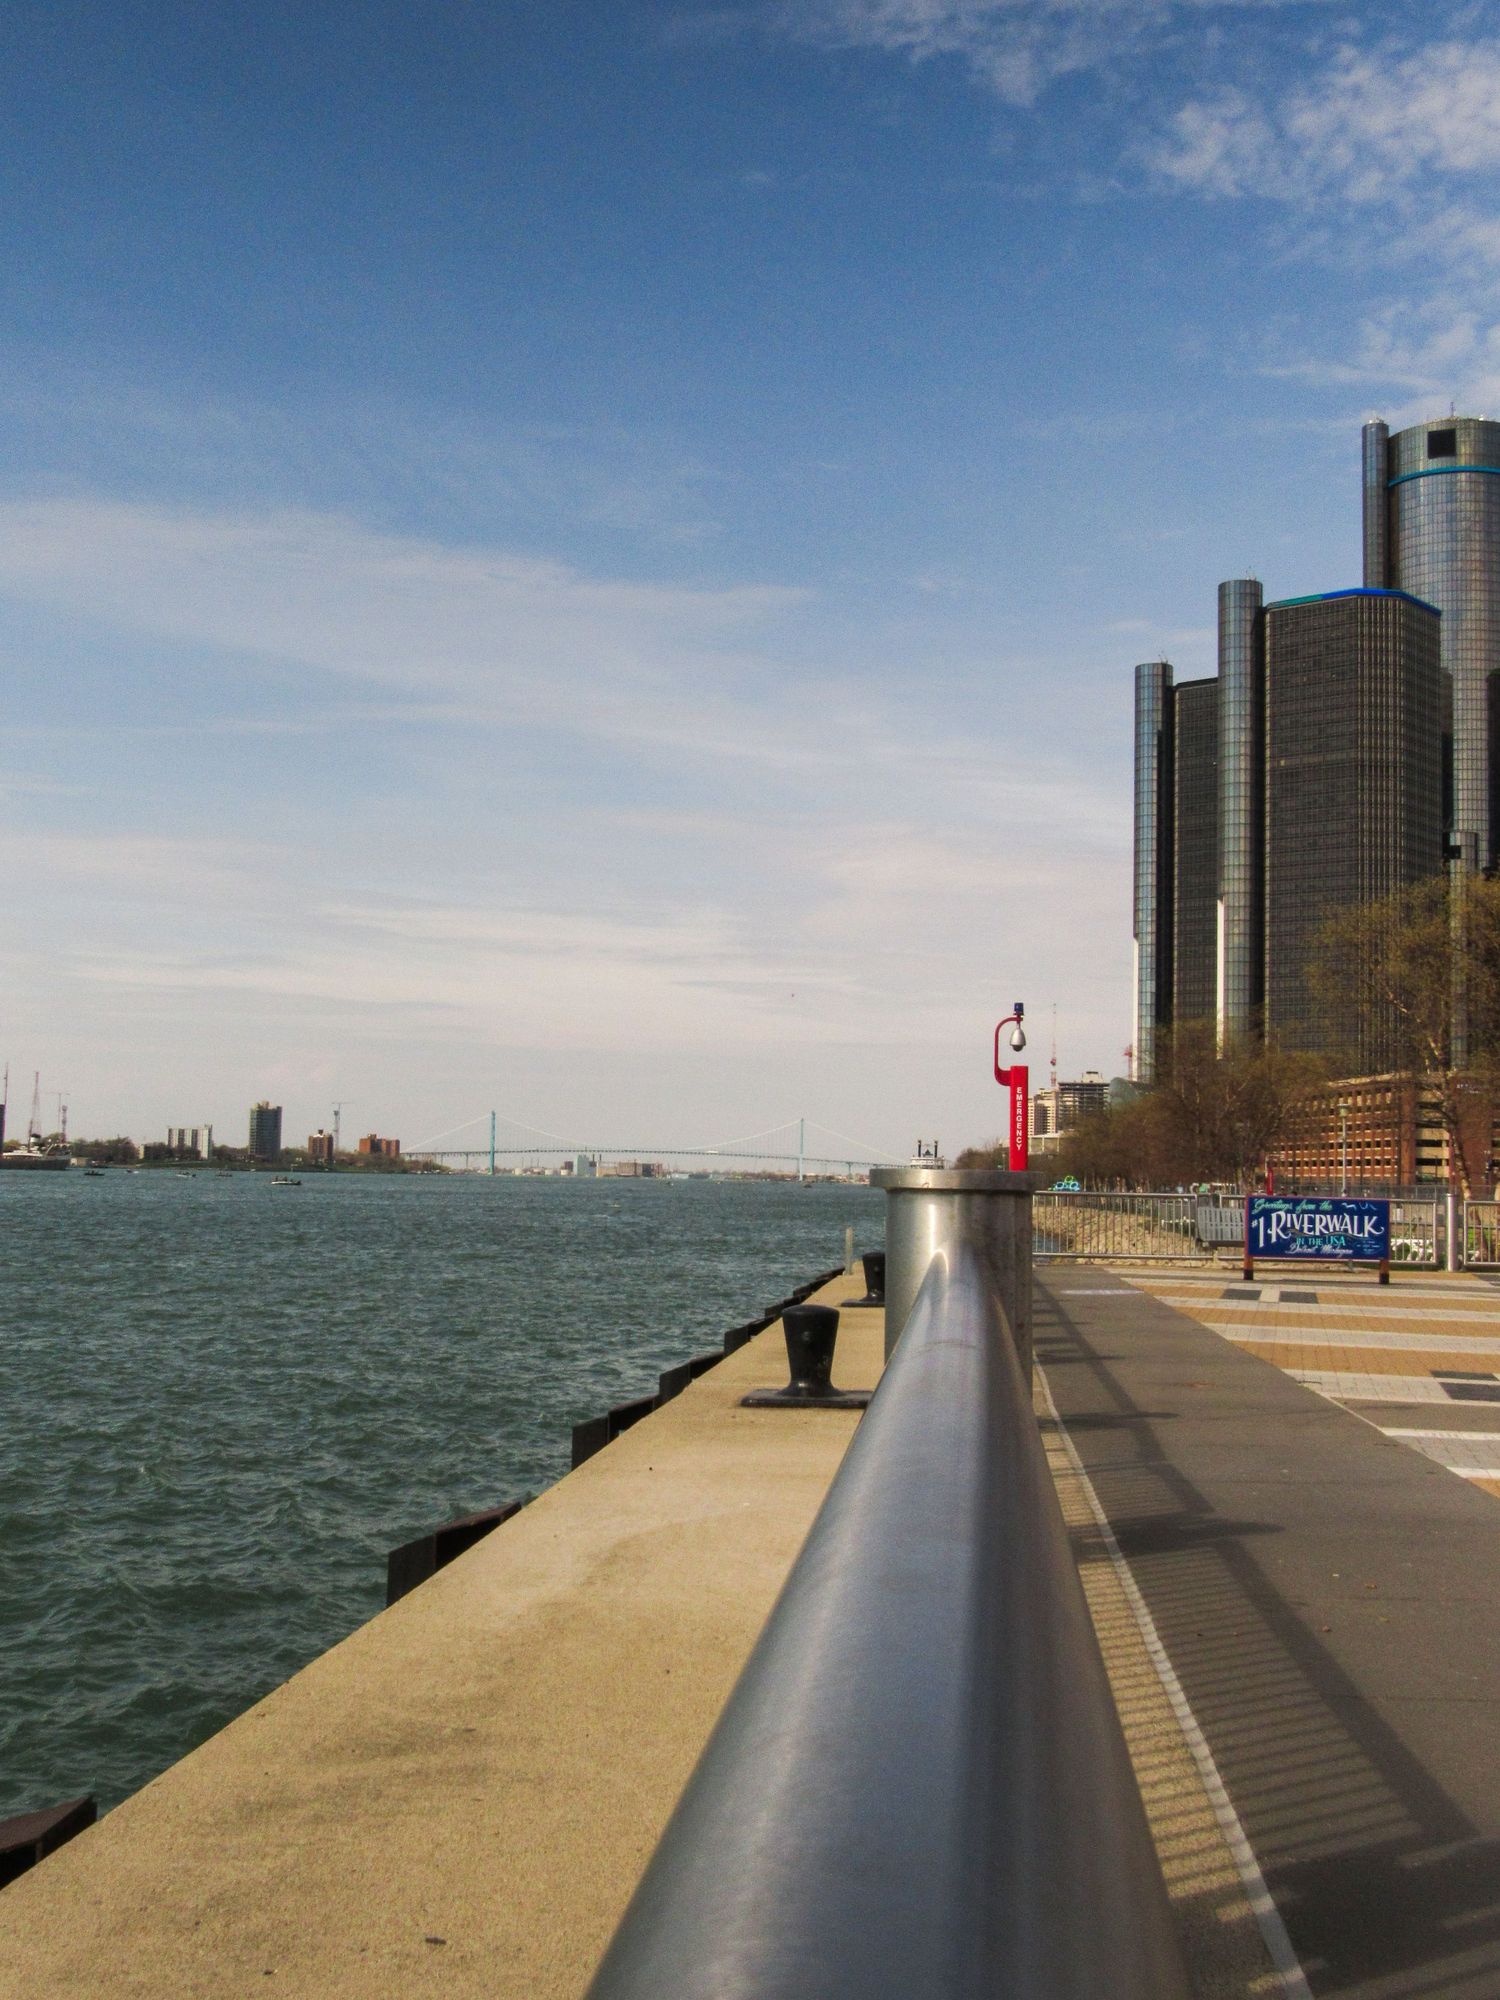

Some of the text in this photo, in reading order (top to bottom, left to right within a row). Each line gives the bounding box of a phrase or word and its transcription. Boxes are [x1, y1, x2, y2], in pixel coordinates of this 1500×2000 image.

[1251, 1198, 1333, 1214] Greetings from the
[1267, 1211, 1385, 1243] RIVERWALK
[1308, 1237, 1323, 1246] THE
[1325, 1235, 1346, 1246] USA
